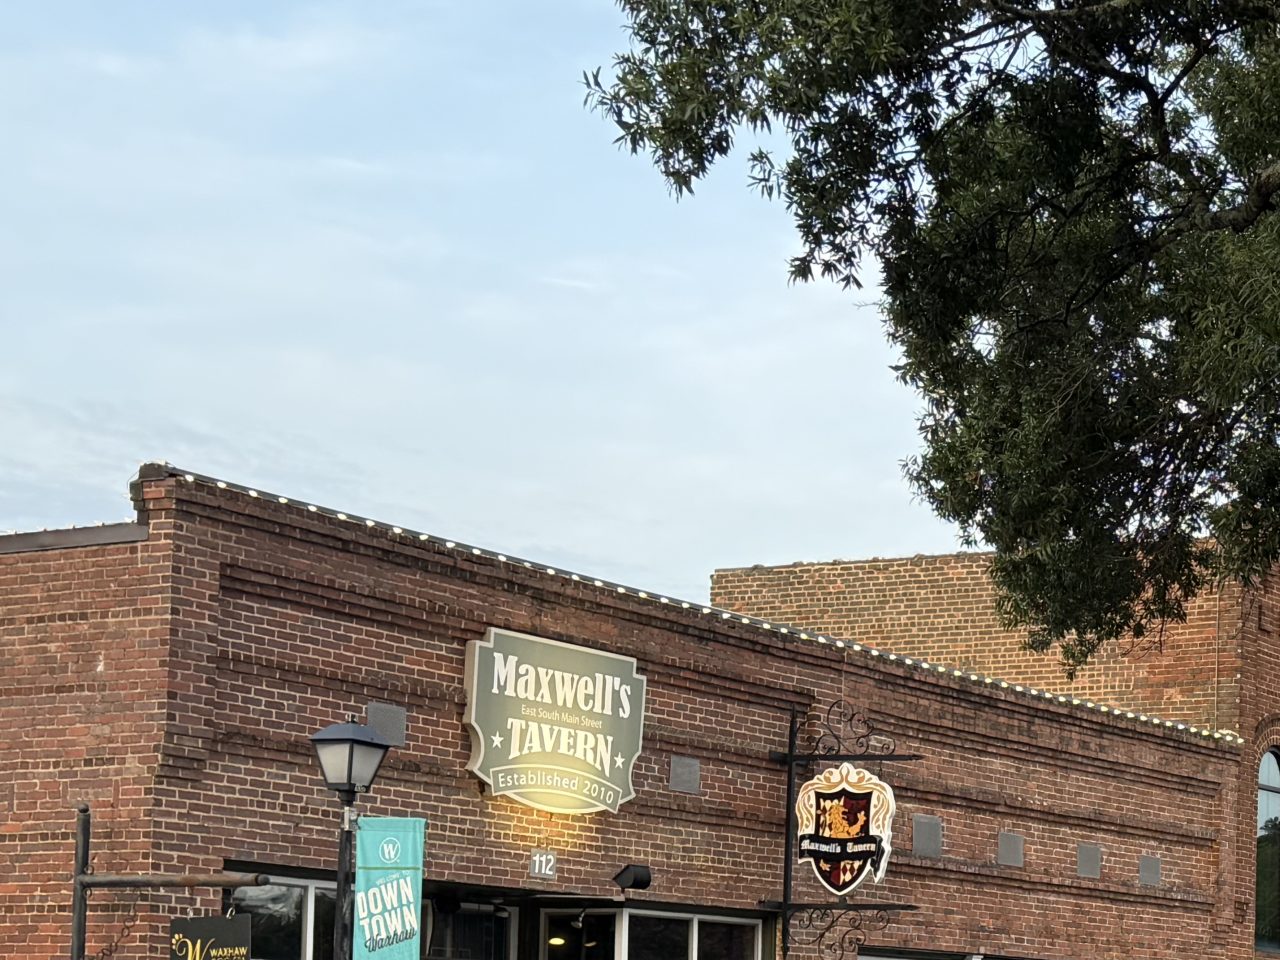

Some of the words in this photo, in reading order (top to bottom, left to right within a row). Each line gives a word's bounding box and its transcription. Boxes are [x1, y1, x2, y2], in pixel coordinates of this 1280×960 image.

[492, 652, 631, 719] Maxwell's
[521, 704, 537, 718] East
[538, 707, 560, 723] South
[561, 712, 580, 726] Main
[581, 715, 603, 729] Street
[507, 717, 614, 778] TAVERN
[498, 772, 578, 791] Established
[582, 779, 614, 804] 2010
[801, 839, 841, 853] Maxwell's
[846, 842, 876, 853] Tavern
[532, 853, 554, 875] 112
[357, 876, 414, 919] DOWN
[360, 903, 418, 942] TOWN
[210, 946, 248, 957] WAXHAW
[365, 926, 417, 953] Waxhaw
